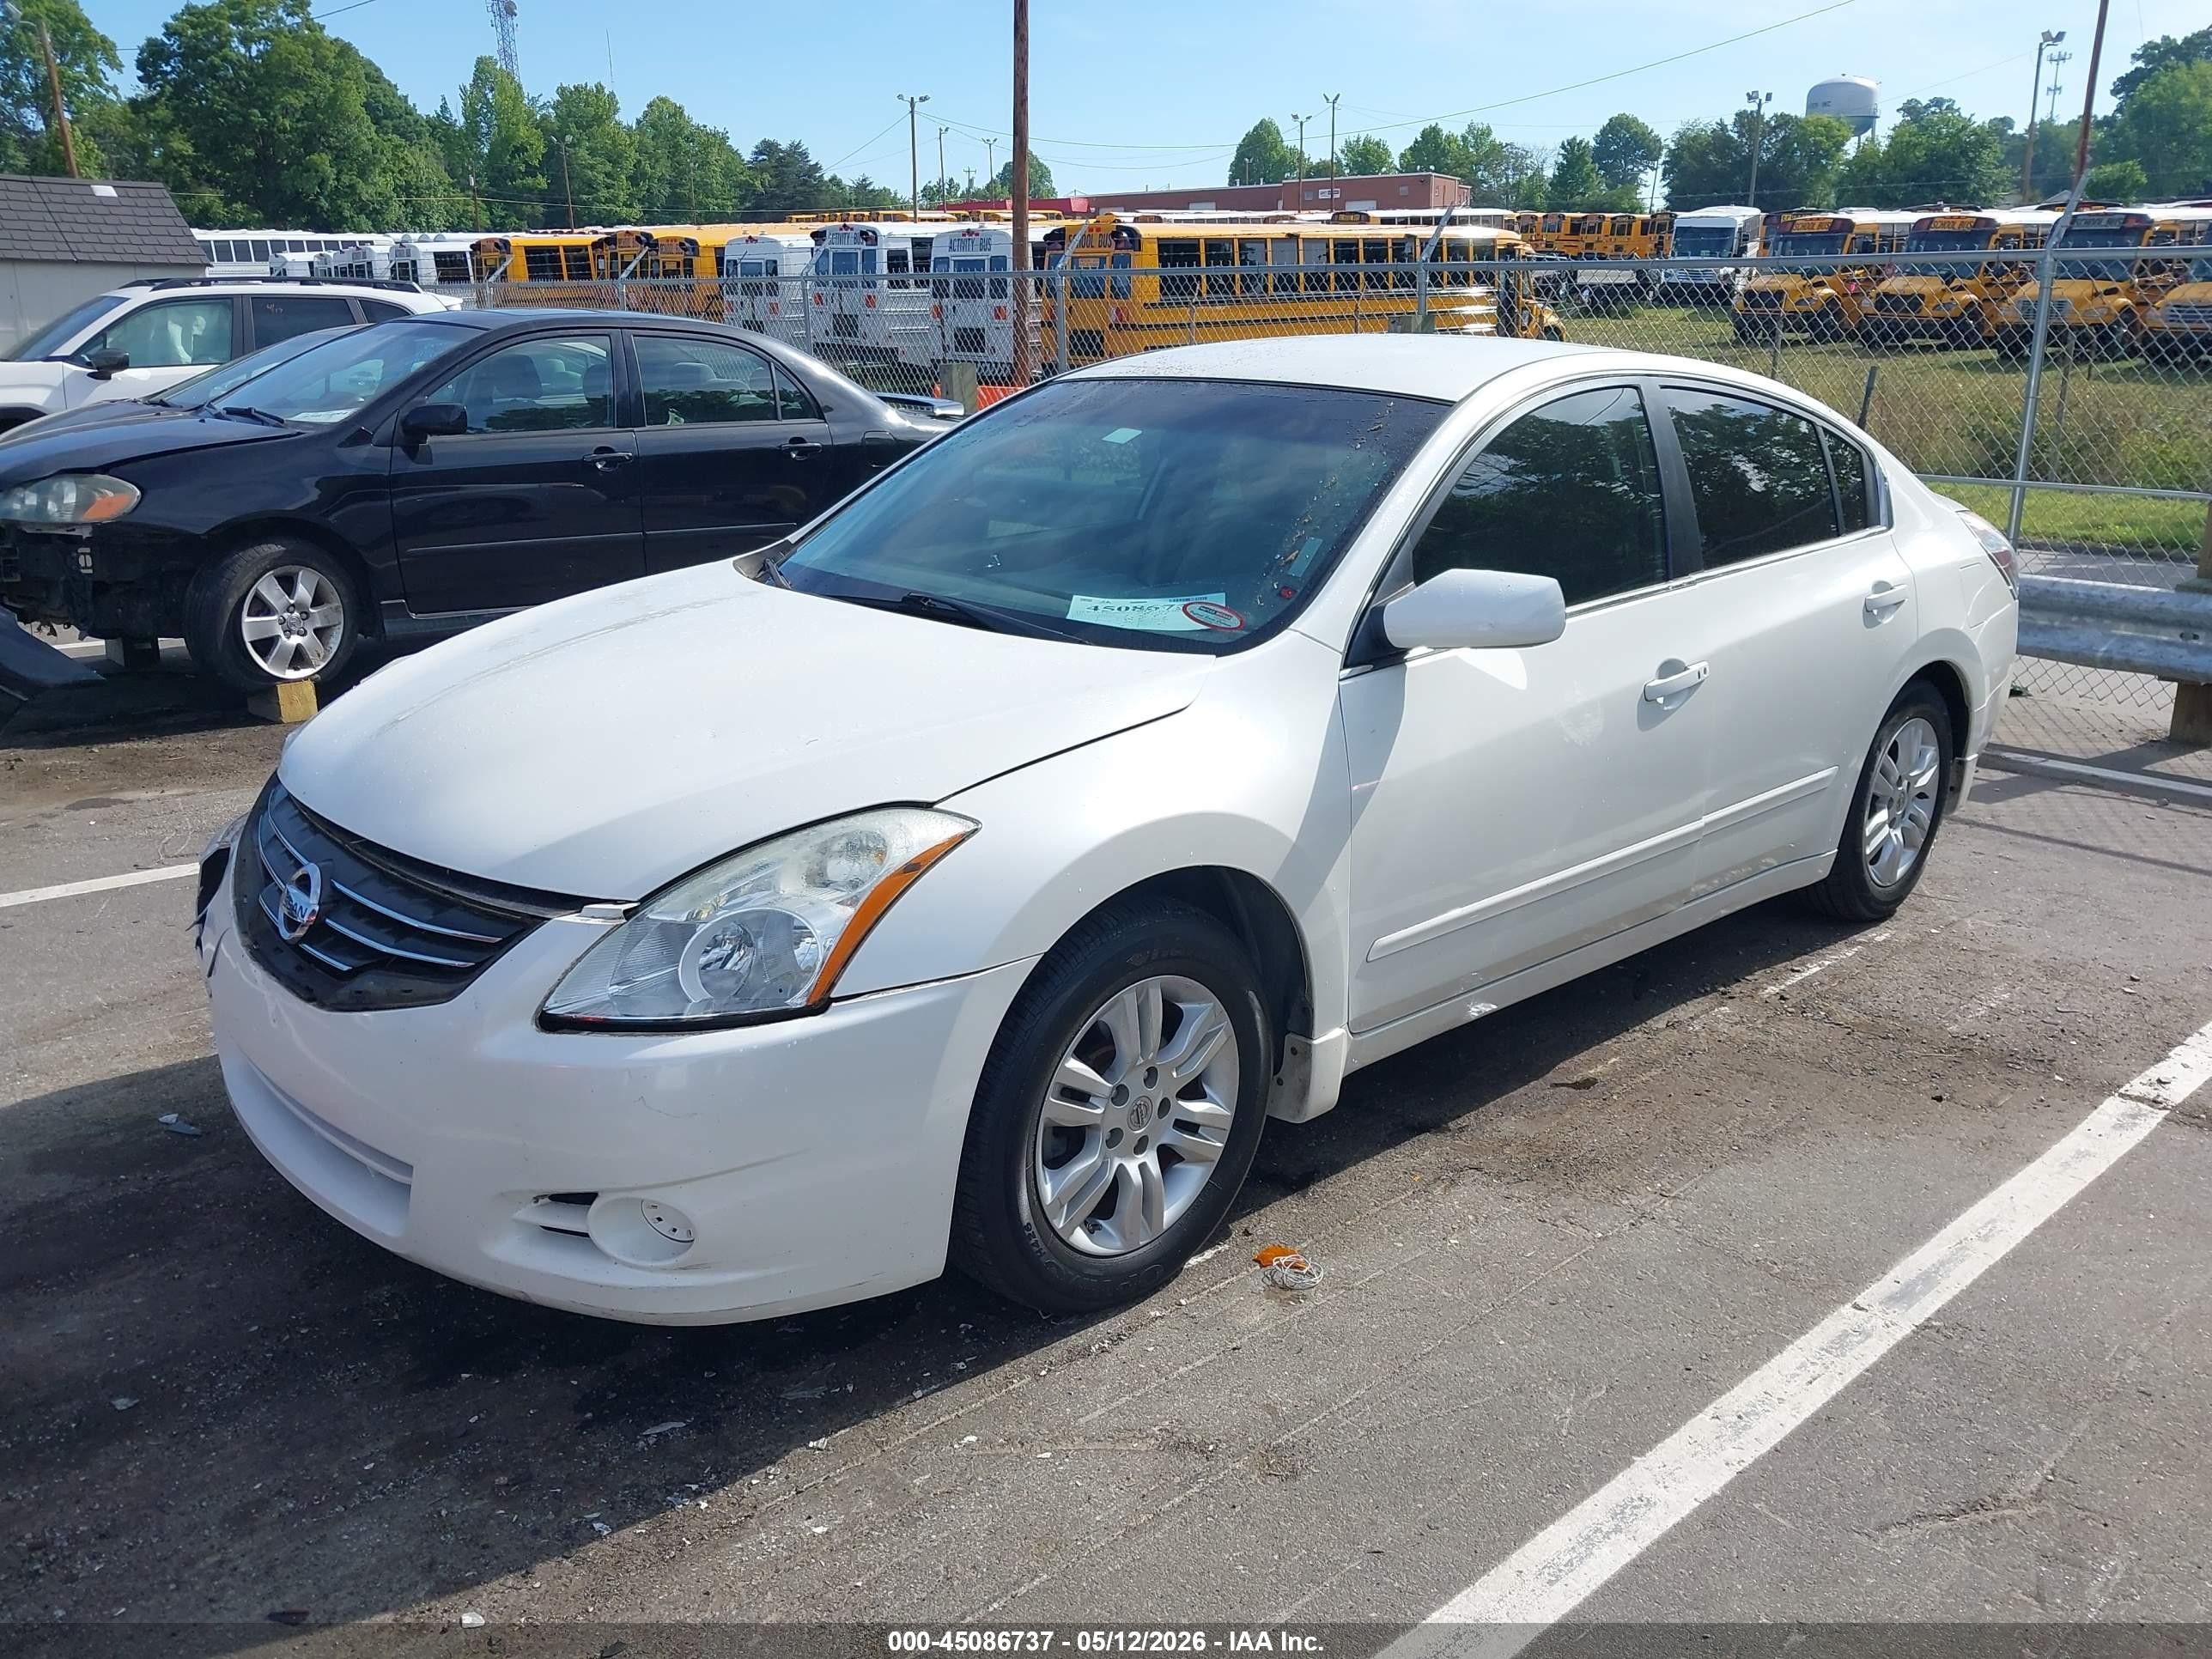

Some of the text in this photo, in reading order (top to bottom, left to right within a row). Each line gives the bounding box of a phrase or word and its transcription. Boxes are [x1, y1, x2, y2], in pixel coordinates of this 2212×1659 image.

[1930, 220, 1974, 229] SCHOOL BUS
[949, 238, 992, 252] ACTIVITY BUS
[1098, 233, 1112, 248] BUS
